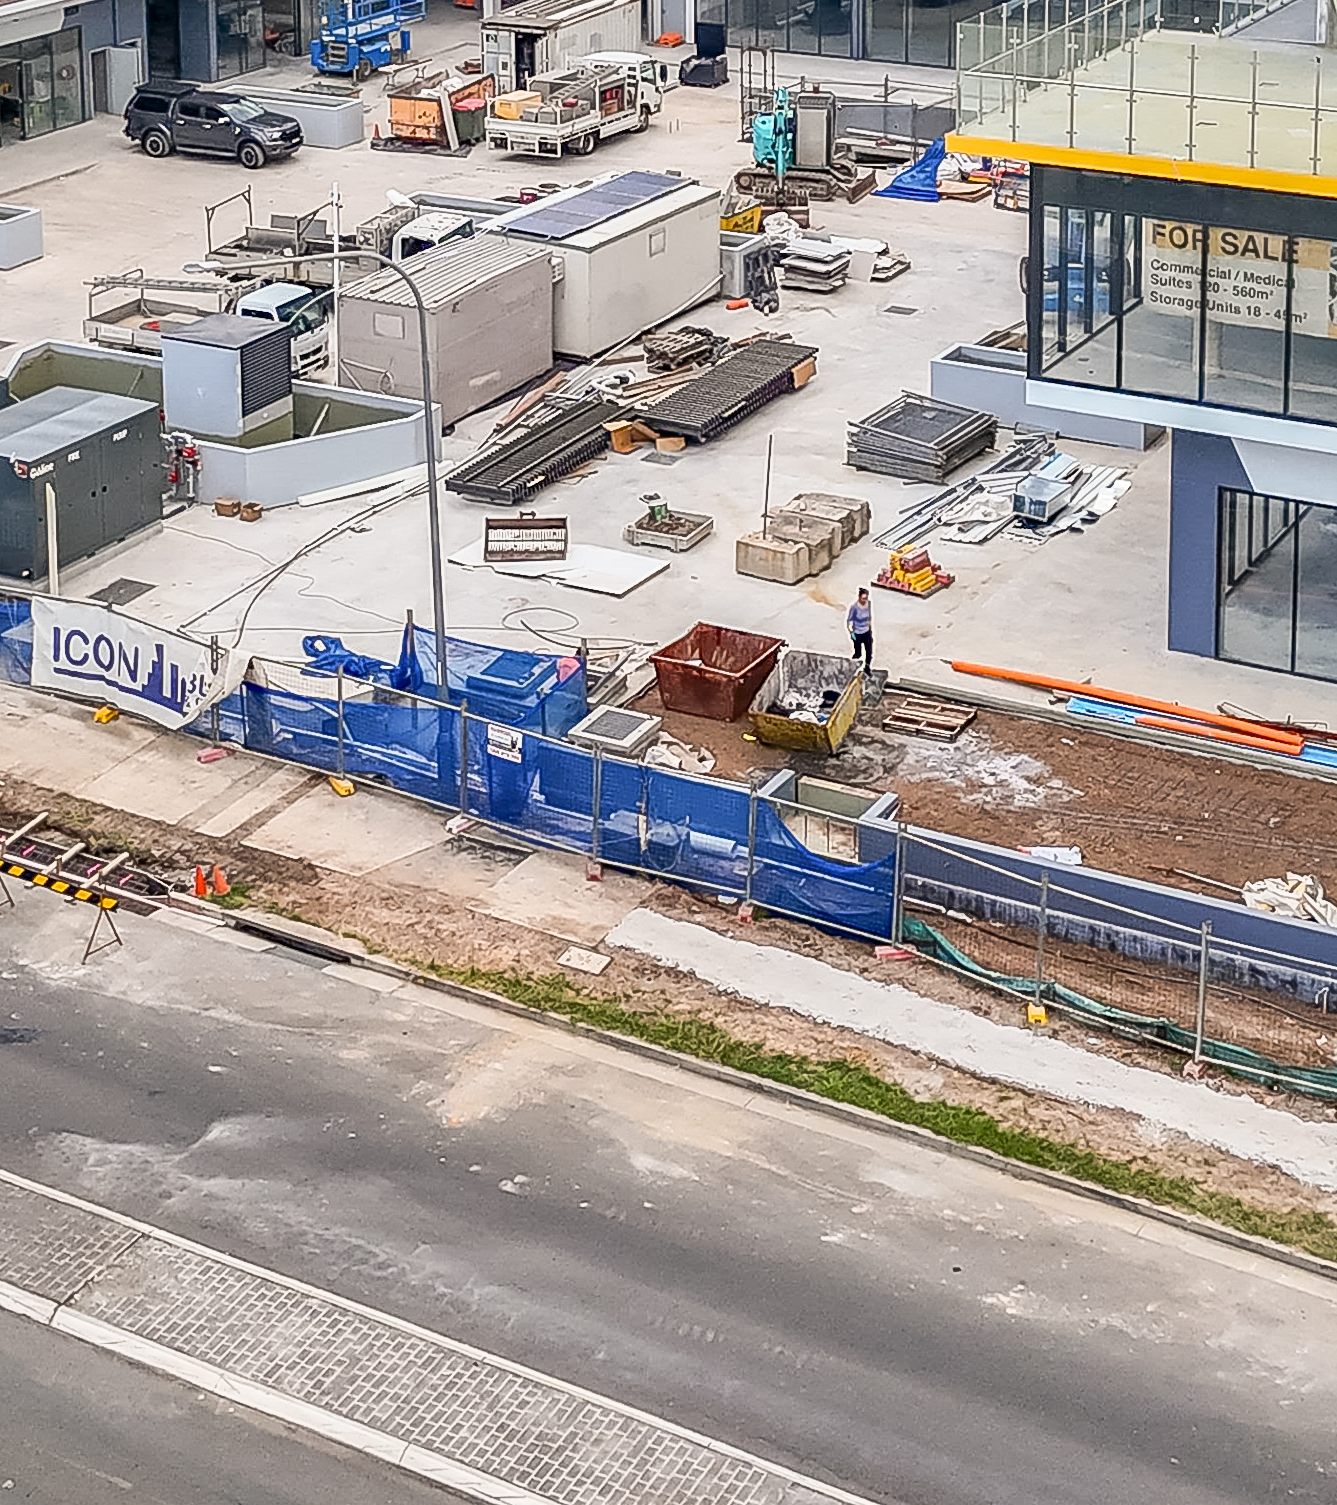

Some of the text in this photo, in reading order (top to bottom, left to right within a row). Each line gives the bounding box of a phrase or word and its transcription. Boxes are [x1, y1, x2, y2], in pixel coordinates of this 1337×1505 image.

[1152, 223, 1300, 264] FOR SALE
[1150, 258, 1232, 281] Commecial
[1150, 273, 1193, 290] Suites
[1246, 304, 1262, 318] 18
[52, 625, 140, 684] ICON
